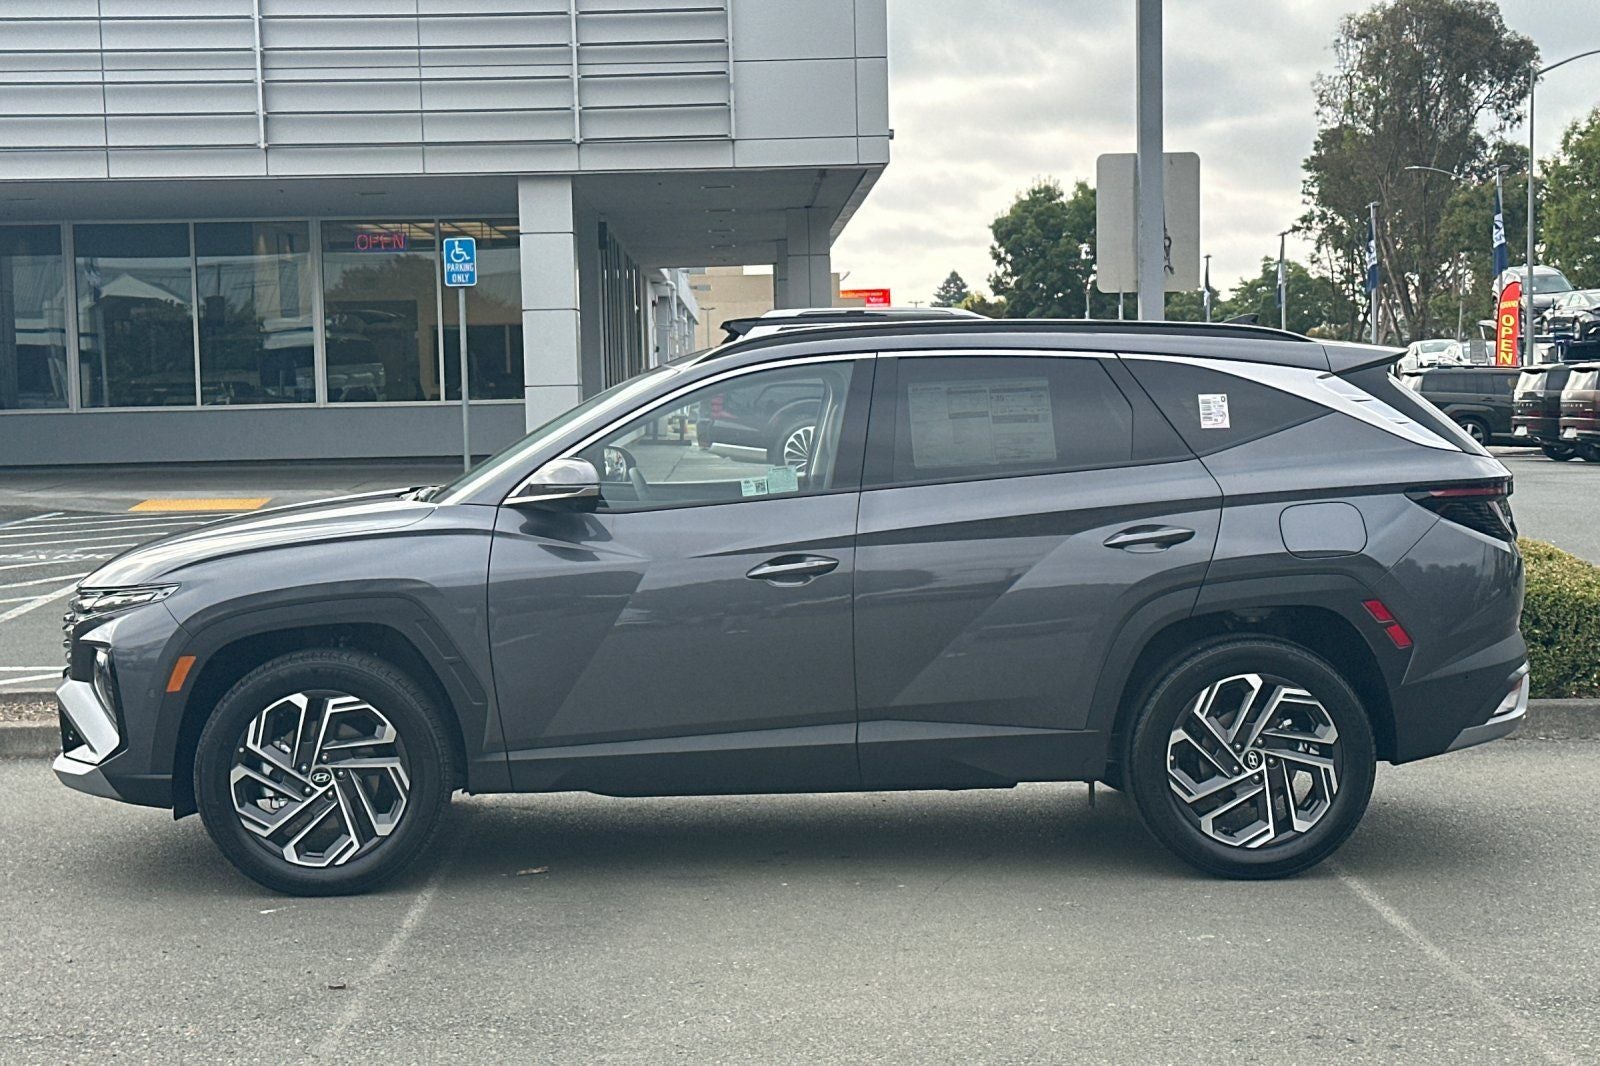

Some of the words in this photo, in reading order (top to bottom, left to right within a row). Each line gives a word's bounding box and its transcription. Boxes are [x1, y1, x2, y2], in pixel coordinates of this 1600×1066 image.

[356, 233, 406, 250] OPEN
[447, 262, 474, 272] PARKING
[452, 273, 470, 283] ONLY
[1500, 314, 1515, 365] OPEN
